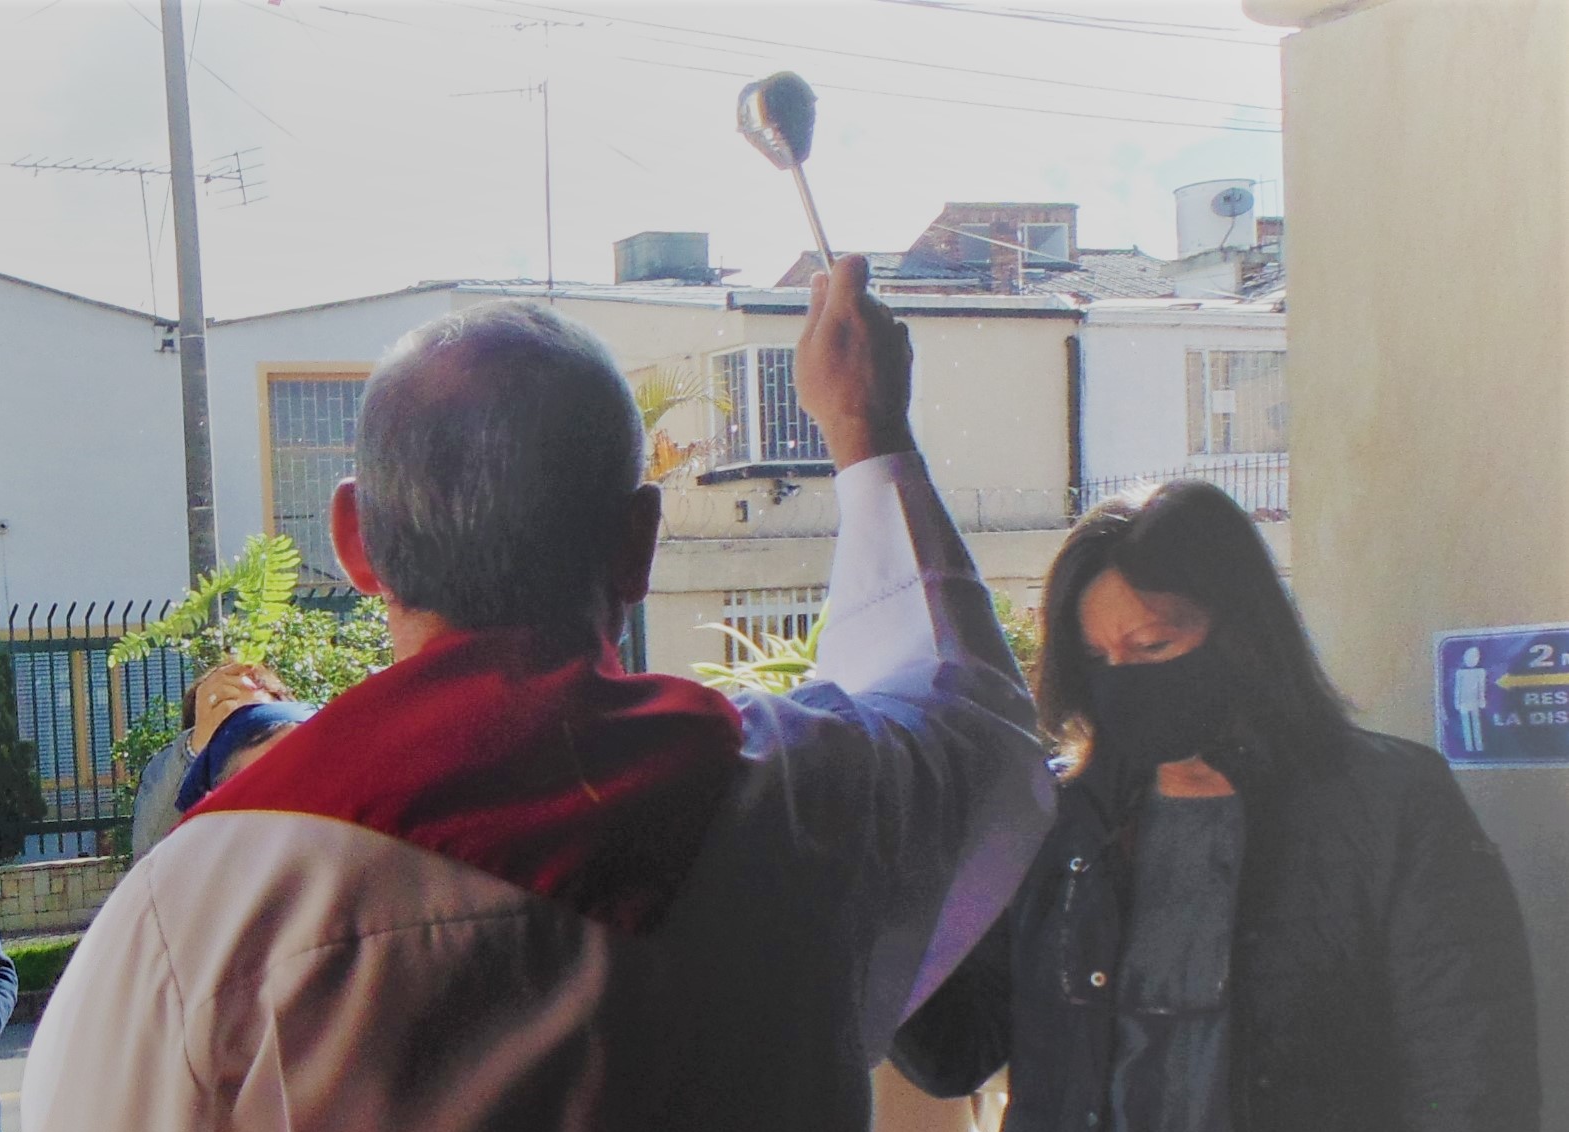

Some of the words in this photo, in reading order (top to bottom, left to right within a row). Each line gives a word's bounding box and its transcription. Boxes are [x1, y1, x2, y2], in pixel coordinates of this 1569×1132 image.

[1529, 644, 1554, 668] 2
[1524, 691, 1568, 705] RES
[1493, 713, 1521, 726] LA
[1530, 711, 1568, 725] DIS
